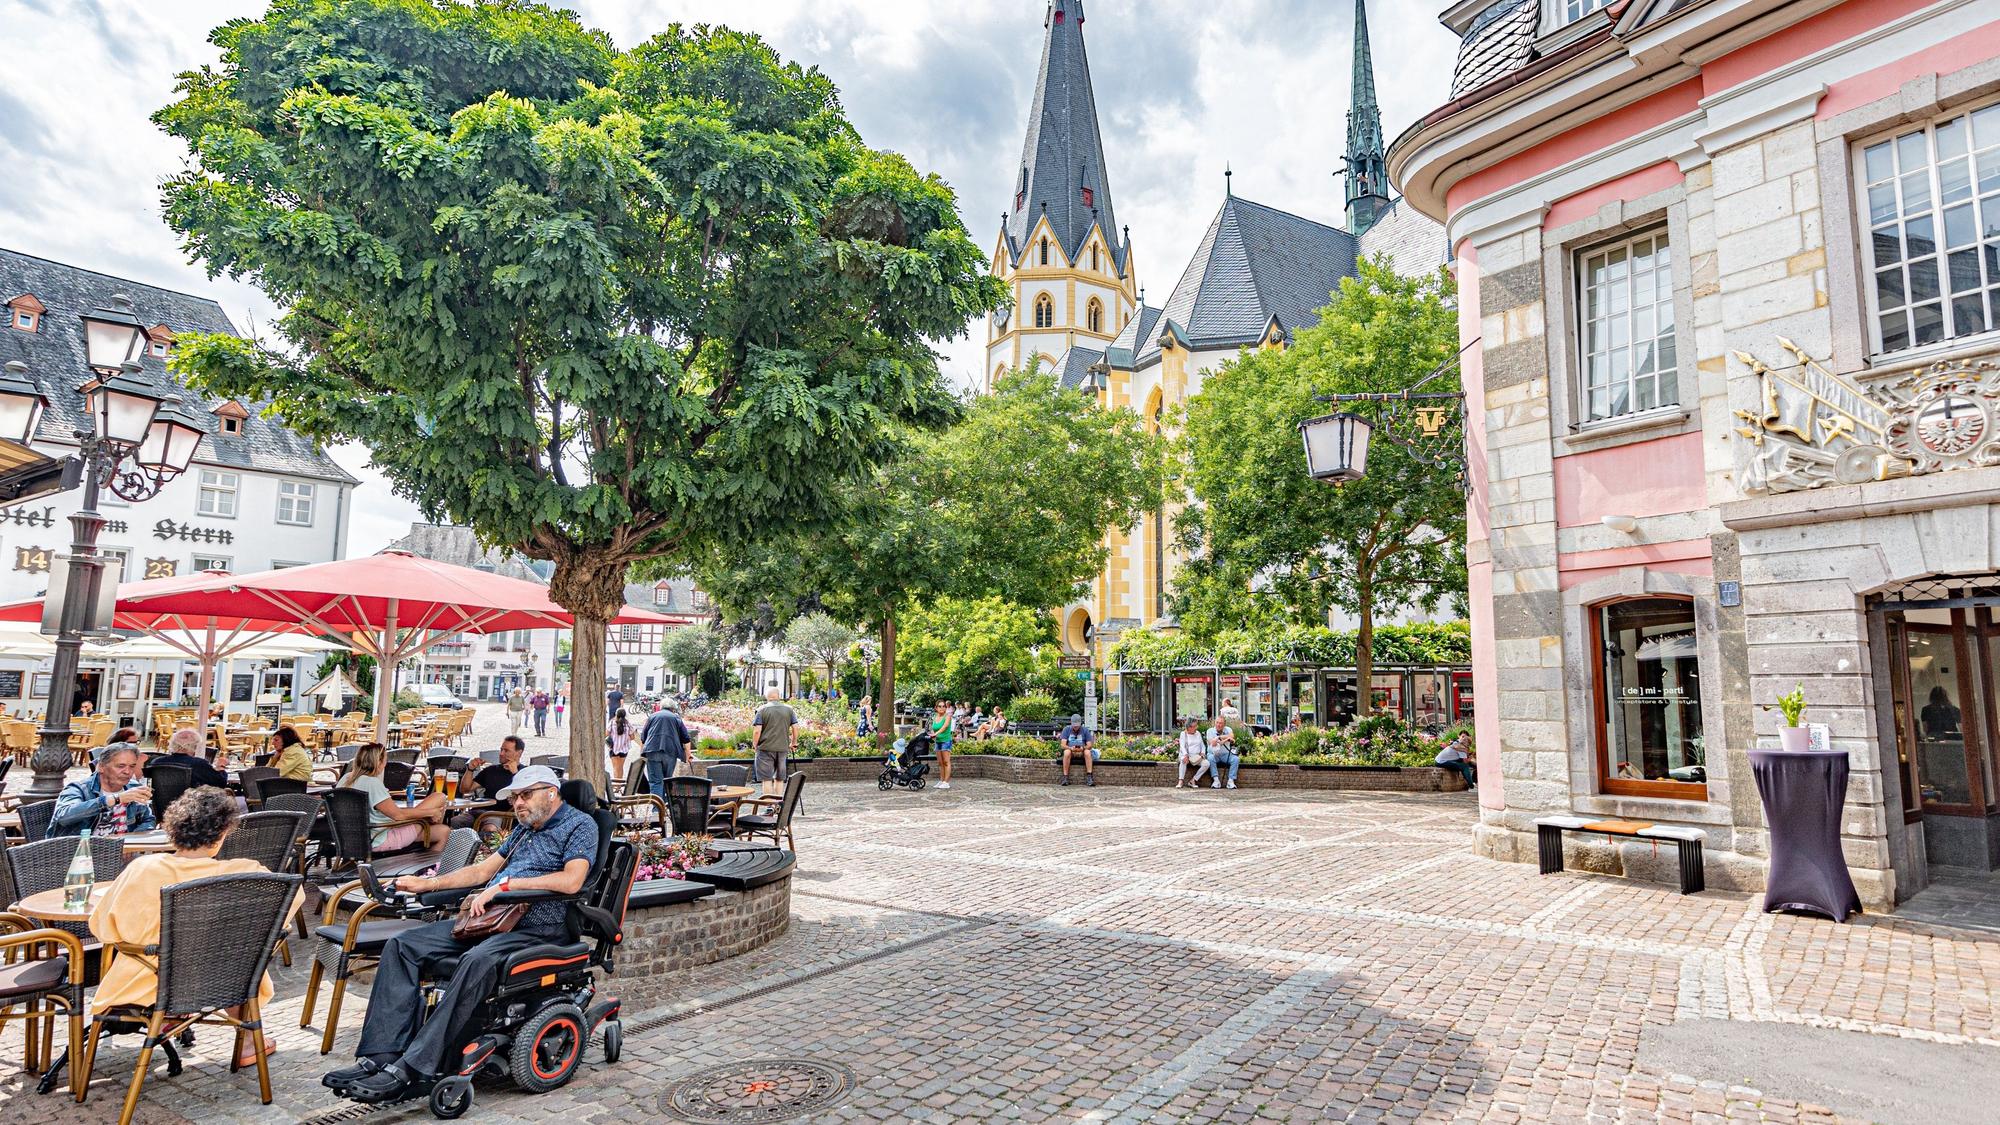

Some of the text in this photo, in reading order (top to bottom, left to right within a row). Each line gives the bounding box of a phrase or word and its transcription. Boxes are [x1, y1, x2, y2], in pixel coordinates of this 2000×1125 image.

[153, 518, 234, 545] Stern
[21, 551, 48, 569] 14
[148, 561, 174, 578] 23
[1663, 686, 1684, 695] parti
